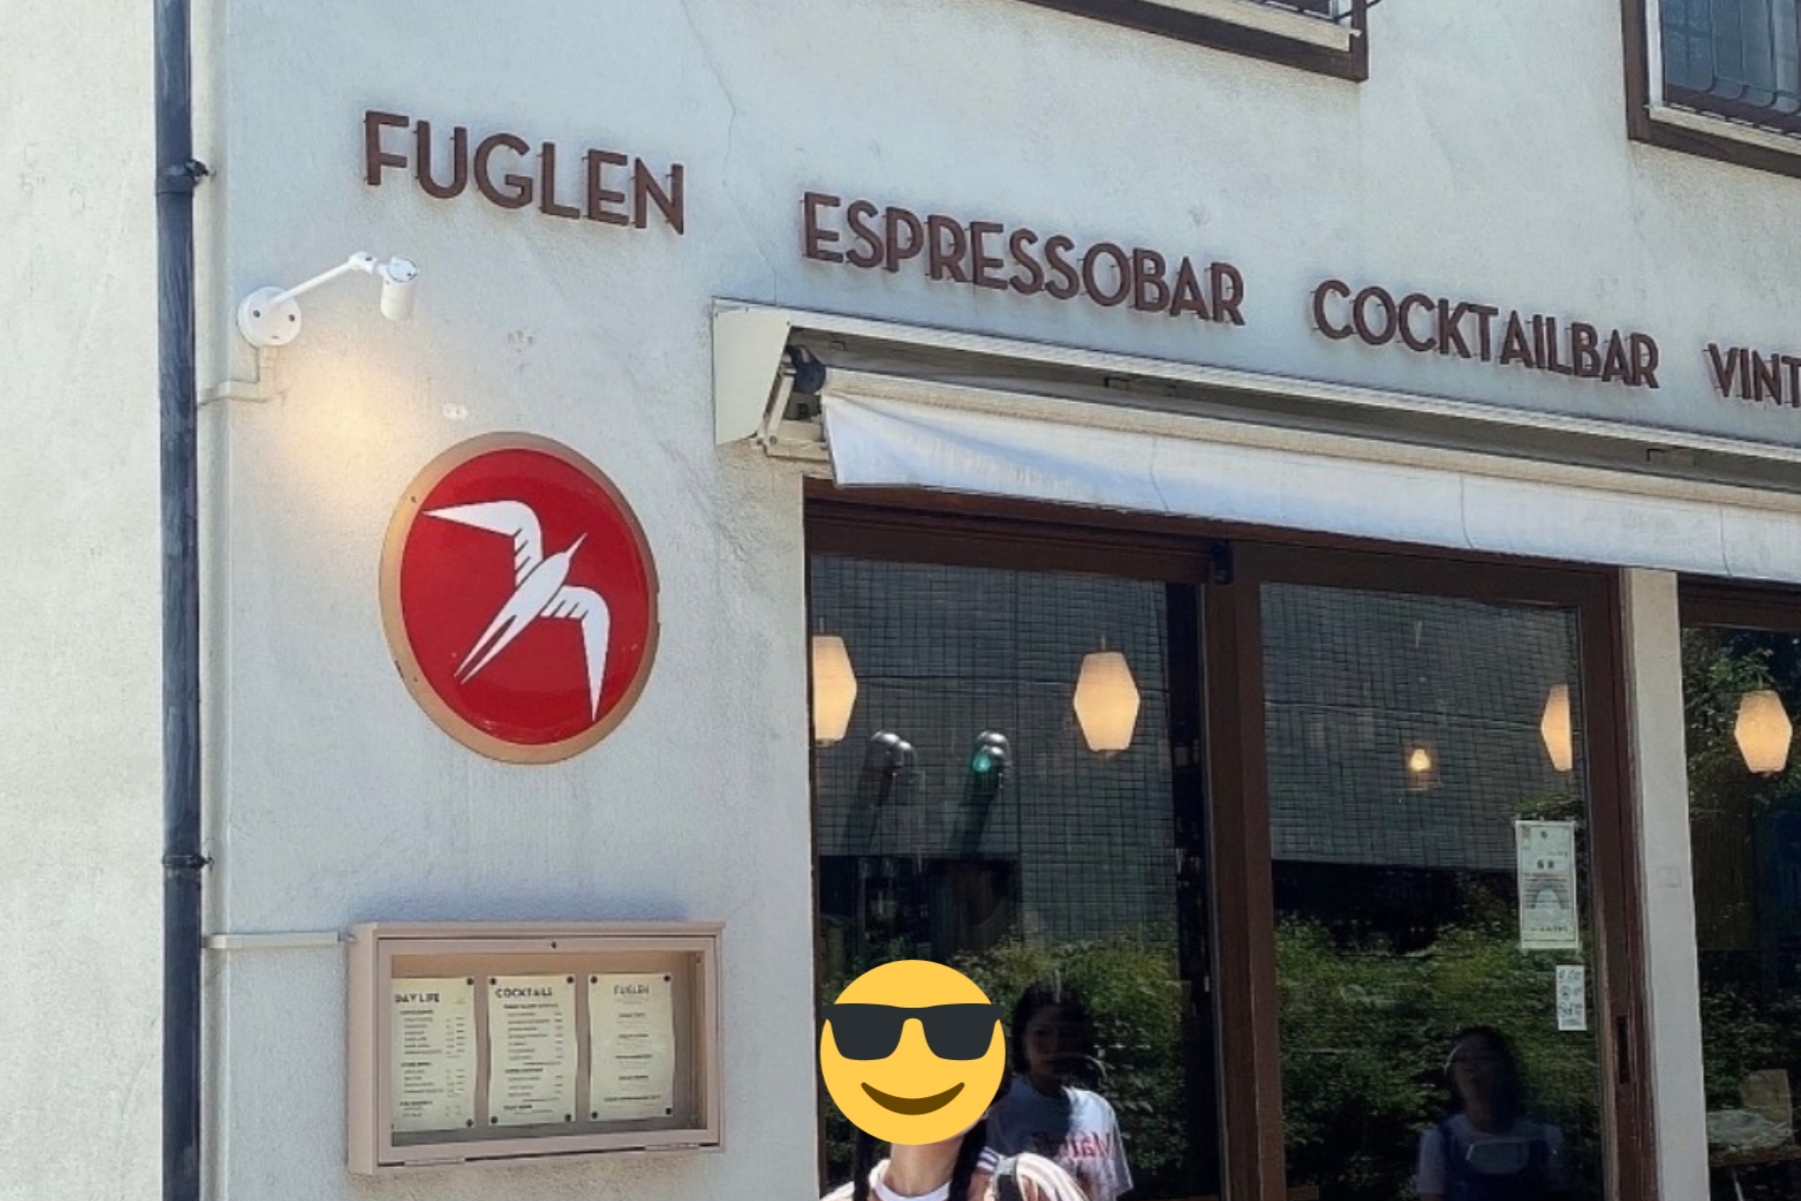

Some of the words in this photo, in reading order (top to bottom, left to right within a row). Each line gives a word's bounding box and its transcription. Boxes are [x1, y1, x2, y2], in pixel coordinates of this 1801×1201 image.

[364, 110, 684, 236] FUGLEN
[803, 191, 1246, 326] ESPRESSOBAR
[1312, 279, 1660, 389] COCKTAILBAR
[1706, 342, 1801, 408] VINT
[395, 993, 417, 1002] DAY
